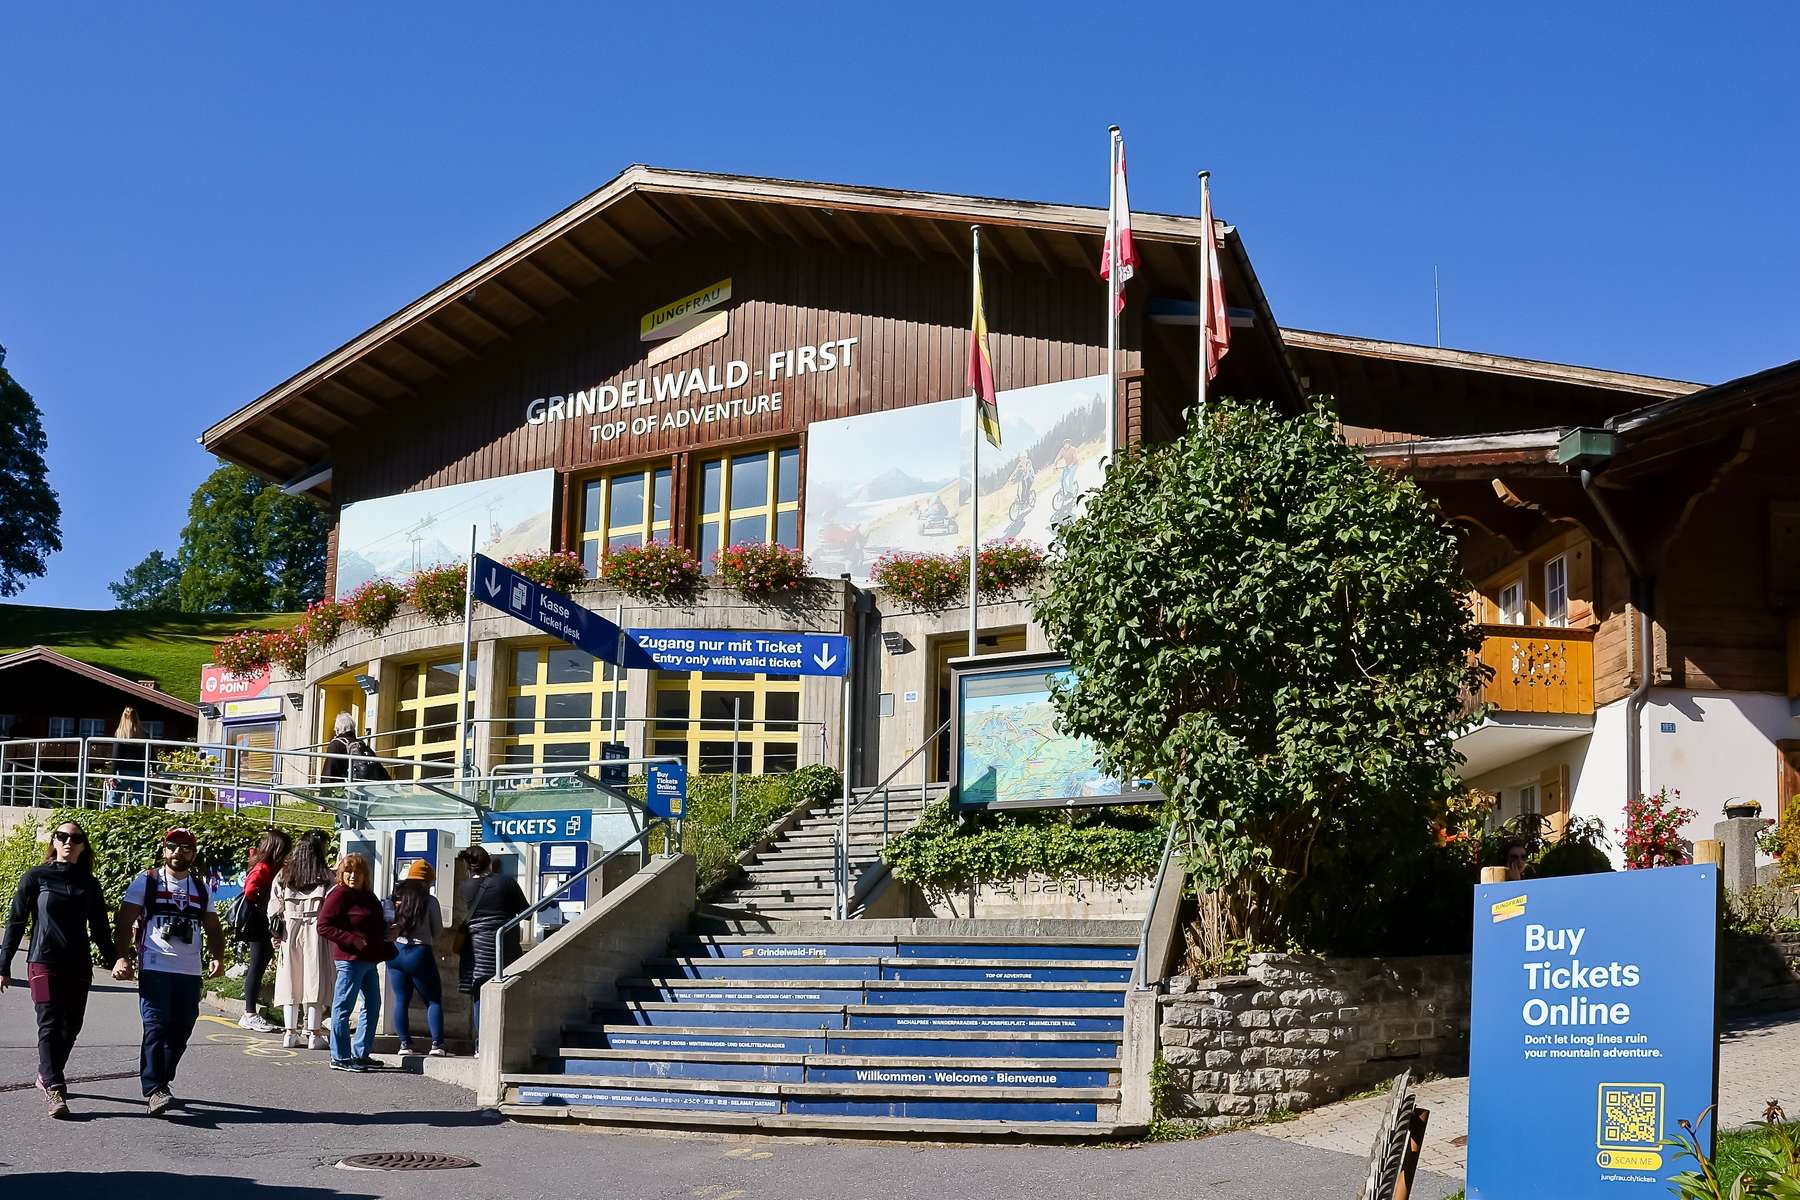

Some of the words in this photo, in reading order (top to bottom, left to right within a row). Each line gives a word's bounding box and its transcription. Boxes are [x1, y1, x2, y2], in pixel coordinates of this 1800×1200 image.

[650, 288, 721, 330] JUNGFRAU
[590, 421, 627, 444] TOP
[632, 415, 657, 436] OF
[661, 392, 782, 431] ADVENTURE
[539, 592, 570, 619] Kasse
[538, 613, 563, 634] Ticket
[563, 620, 581, 641] desk
[638, 635, 695, 653] Zugang
[699, 639, 725, 652] nur
[728, 639, 752, 652] mit
[755, 639, 802, 654] Ticket
[652, 653, 682, 667] Entry
[685, 654, 709, 667] only
[712, 654, 737, 666] with
[739, 655, 766, 667] valid
[768, 656, 802, 668] ticket
[219, 682, 249, 694] POINT
[656, 771, 669, 779] Buy
[492, 818, 556, 836] TICKETS
[1525, 924, 1585, 955] Buy
[757, 948, 827, 956] Grindelwald-First
[1523, 959, 1640, 990] Tickets
[1522, 996, 1630, 1026] Online
[1524, 1034, 1552, 1045] Don't
[1554, 1034, 1568, 1044] let
[1570, 1034, 1594, 1046] long
[1596, 1034, 1623, 1044] lines
[1625, 1033, 1648, 1044] ruin
[1524, 1049, 1547, 1059] your
[1550, 1048, 1600, 1058] mountain
[1603, 1047, 1663, 1058] adventure.
[856, 1070, 926, 1082] Willkommen
[935, 1072, 988, 1083] Welcome
[996, 1072, 1057, 1084] Bienvenue
[1615, 1156, 1637, 1165] SCAN
[1640, 1157, 1653, 1165] ME
